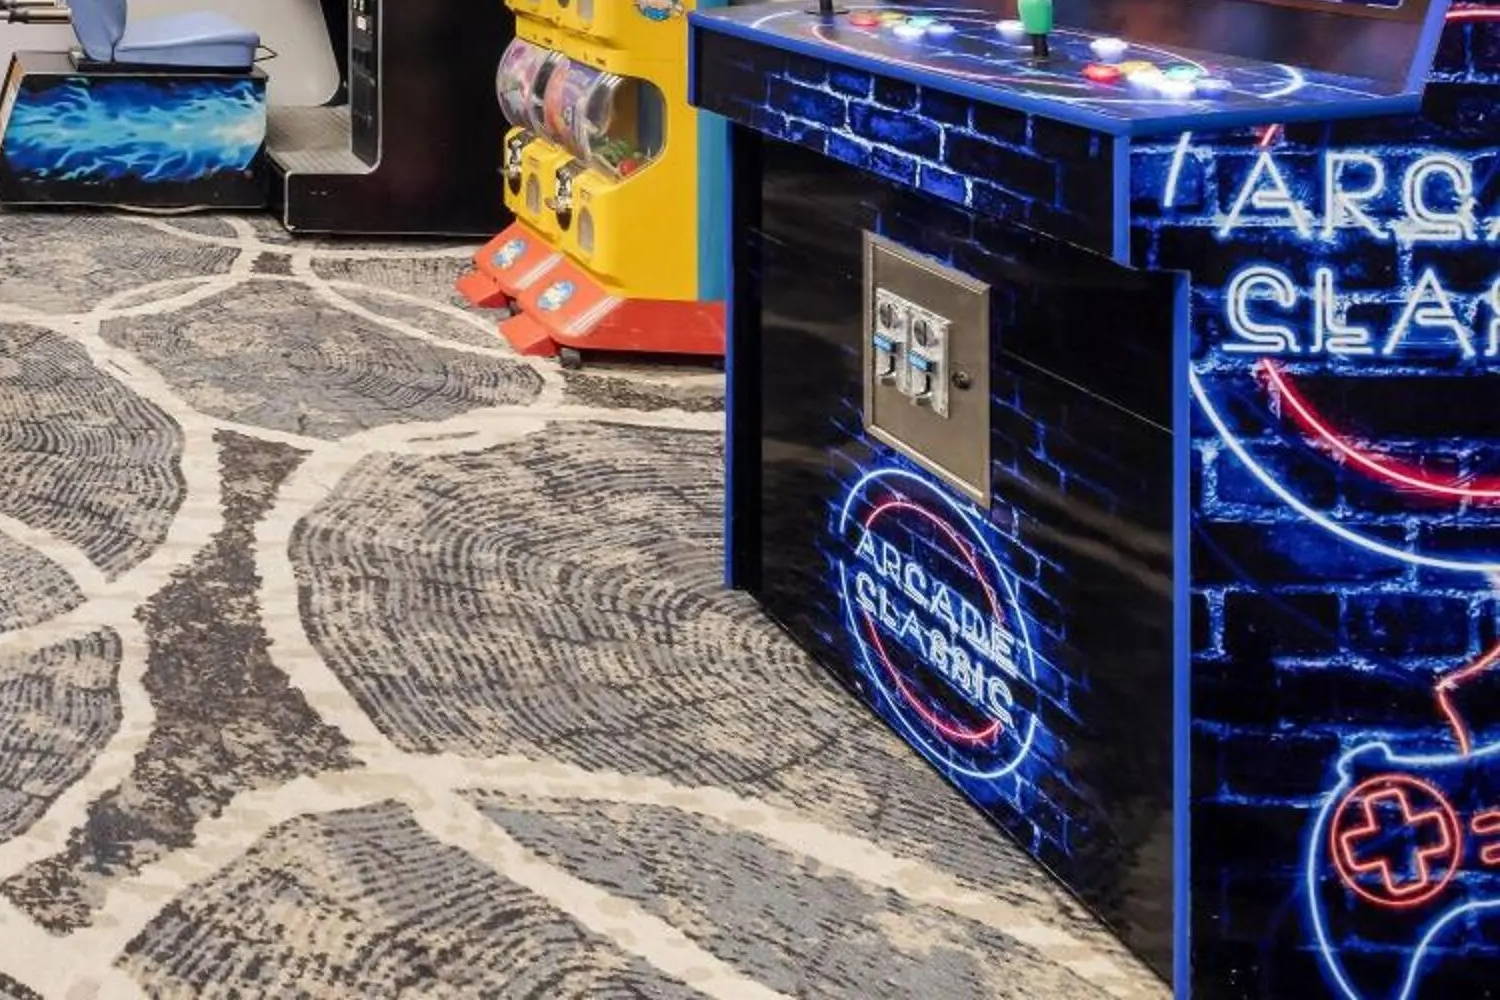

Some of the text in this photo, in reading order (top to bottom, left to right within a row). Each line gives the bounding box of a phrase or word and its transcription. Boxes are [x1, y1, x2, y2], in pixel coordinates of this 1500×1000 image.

[1218, 150, 1500, 241] ARC
[1222, 264, 1500, 358] CLA
[854, 529, 1020, 680] ARCADE
[855, 571, 1016, 729] CLASSIC
